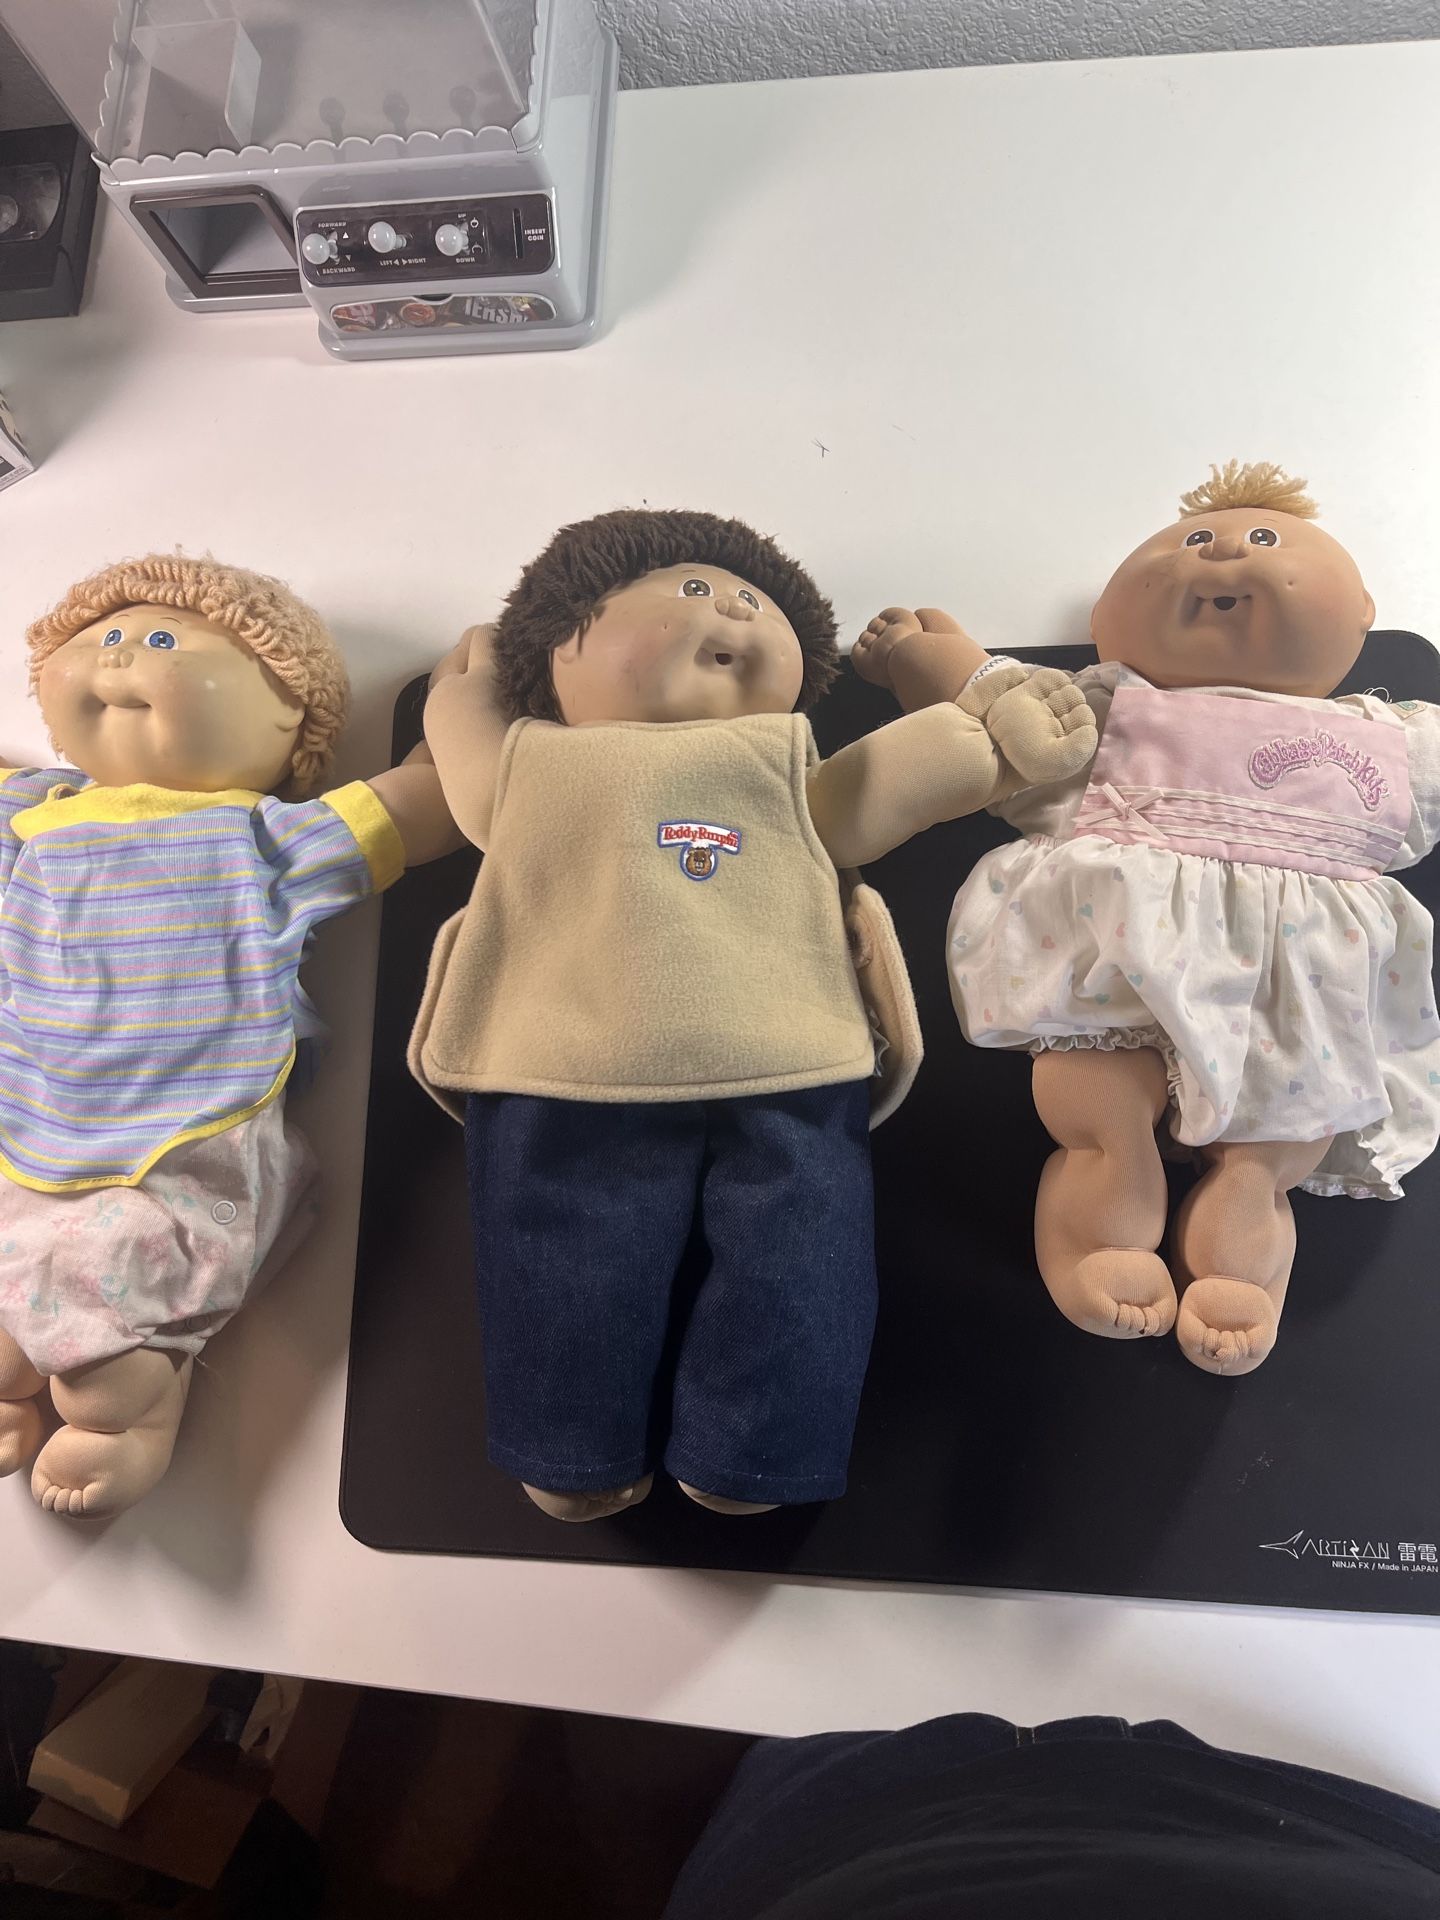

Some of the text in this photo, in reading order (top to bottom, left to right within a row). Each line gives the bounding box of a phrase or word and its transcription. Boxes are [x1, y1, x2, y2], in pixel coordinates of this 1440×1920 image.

[408, 257, 427, 265] RIGHT
[322, 266, 356, 275] BACKWARD
[663, 826, 697, 842] Teddy
[1397, 1542, 1438, 1563] 雷電
[1332, 1560, 1356, 1569] NINJA
[1358, 1561, 1370, 1569] FX
[1377, 1562, 1400, 1571] Made
[1401, 1563, 1409, 1572] in
[1411, 1564, 1439, 1573] JAPAN
